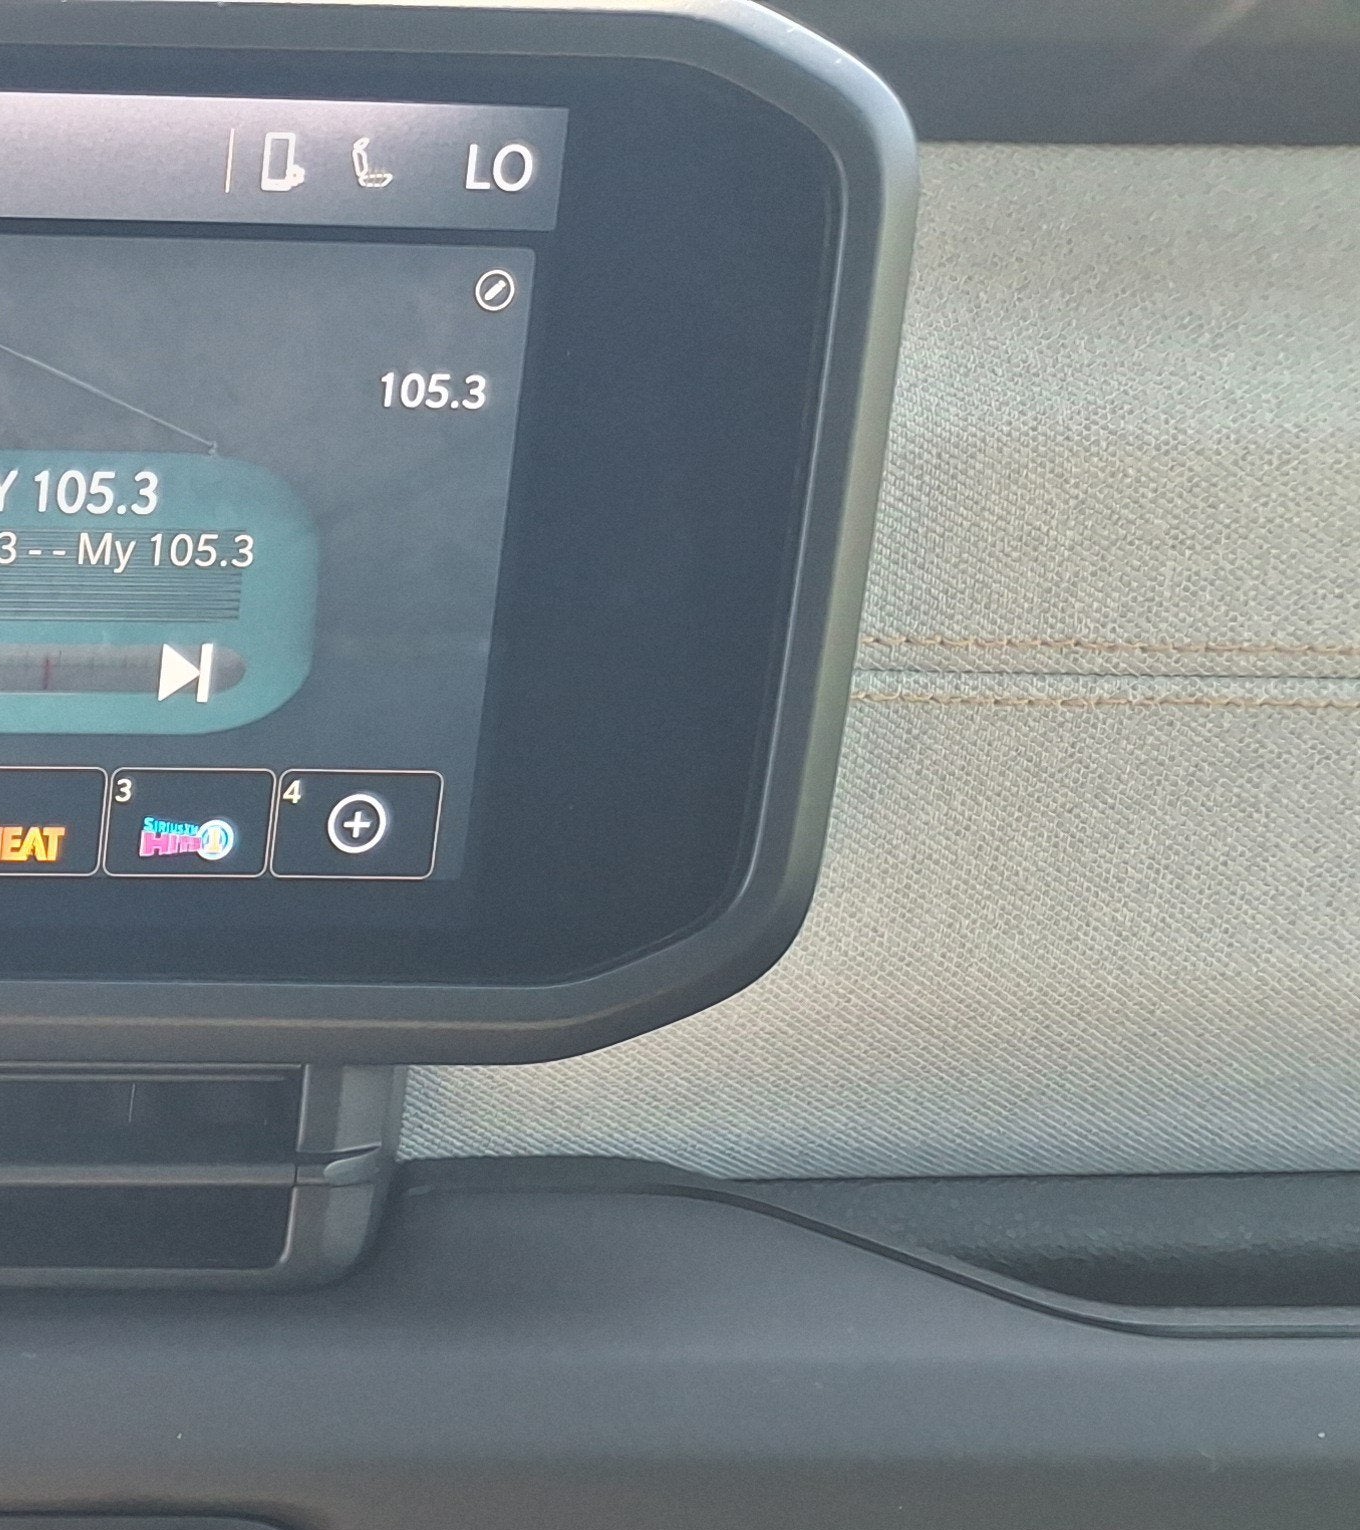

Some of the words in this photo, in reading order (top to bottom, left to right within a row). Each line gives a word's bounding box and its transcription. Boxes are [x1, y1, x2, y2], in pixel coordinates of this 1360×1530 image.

[465, 143, 534, 192] LO
[380, 371, 487, 411] 105.3
[33, 470, 159, 516] 105.3
[77, 532, 137, 574] My
[150, 533, 255, 569] 105.3
[115, 778, 132, 802] 3
[282, 779, 302, 804] 4
